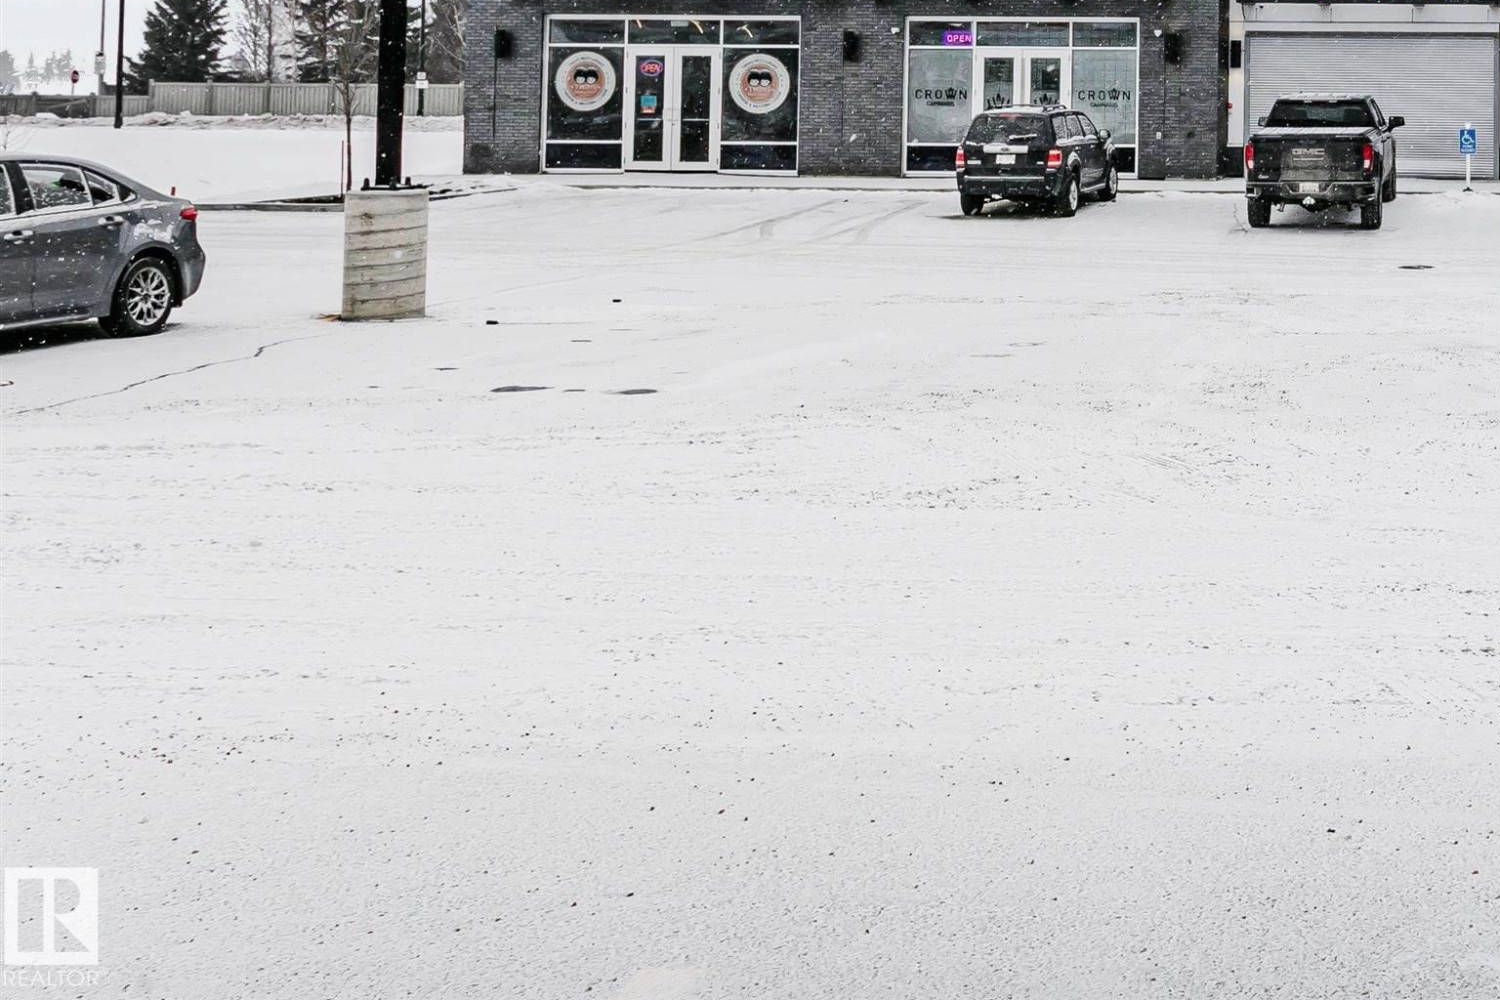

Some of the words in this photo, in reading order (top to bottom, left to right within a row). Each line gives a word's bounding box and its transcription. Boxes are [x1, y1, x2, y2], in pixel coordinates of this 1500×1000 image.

[946, 34, 972, 43] OPEN
[914, 86, 968, 100] CROWN
[1078, 87, 1131, 101] CROWN
